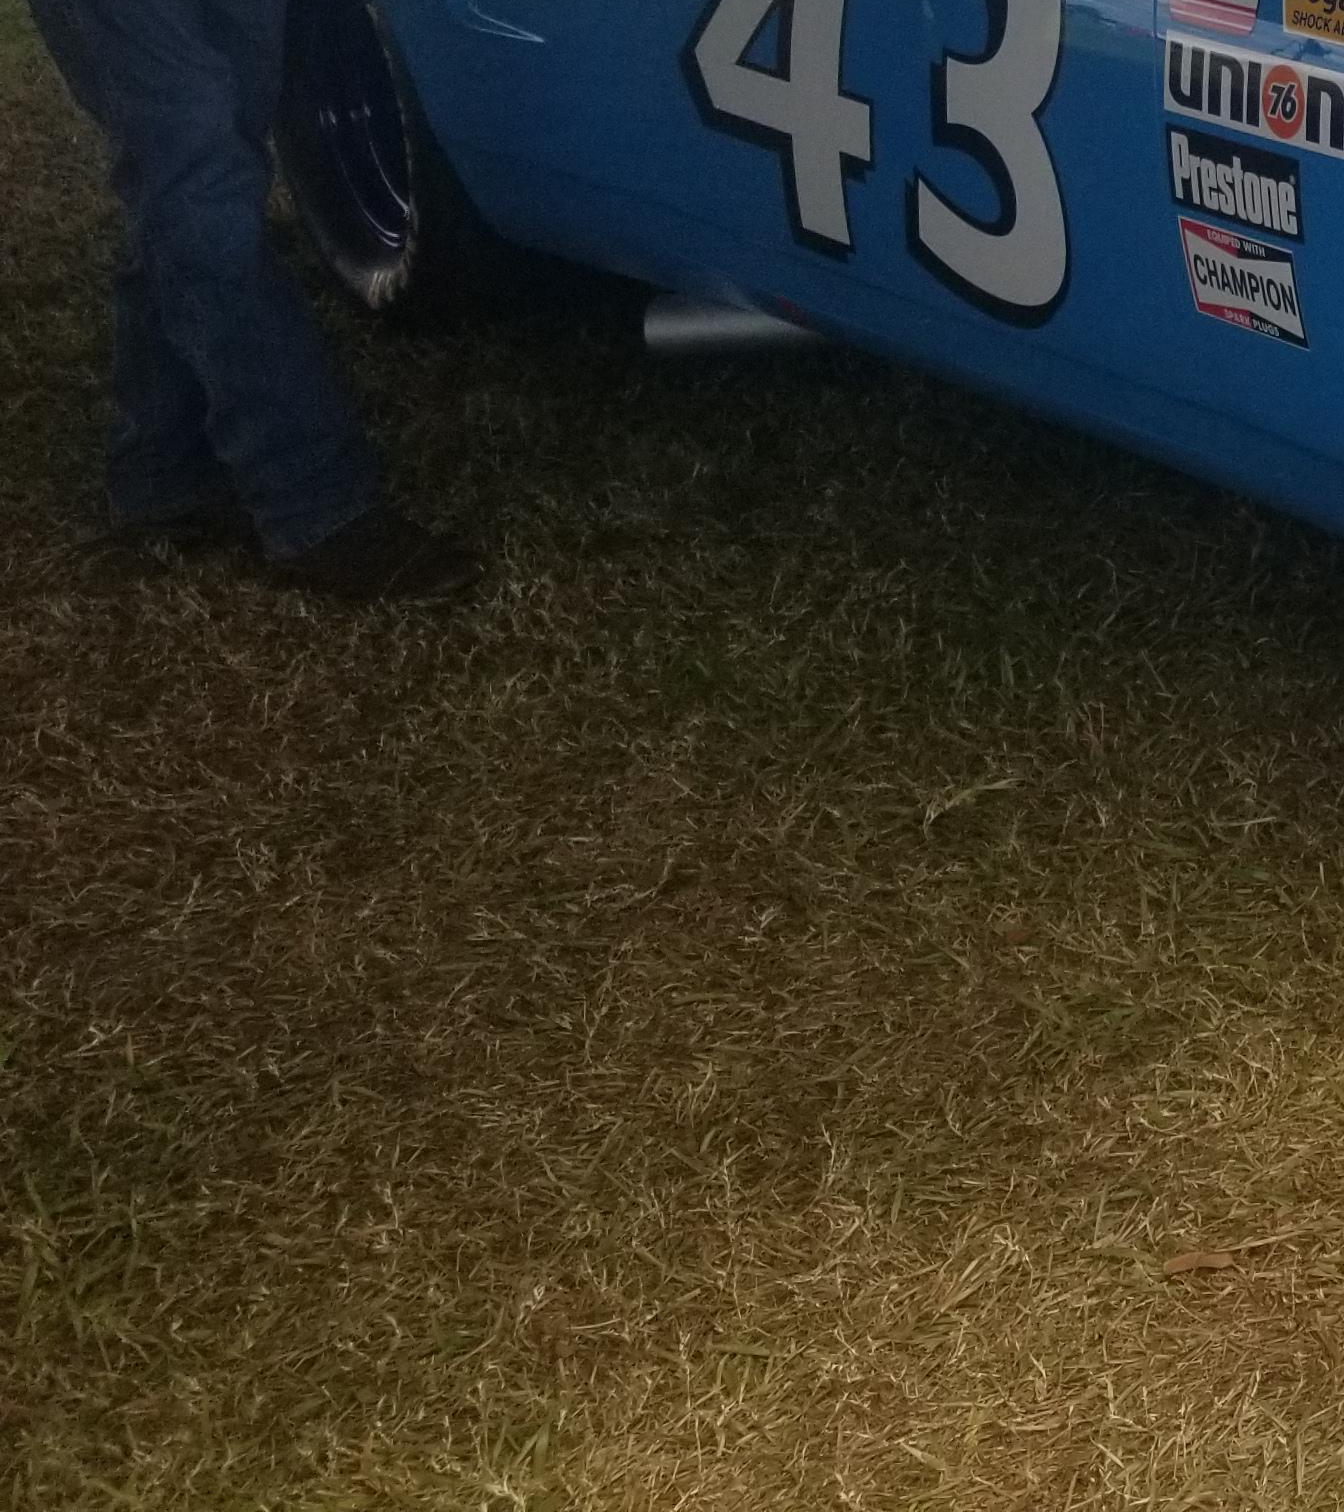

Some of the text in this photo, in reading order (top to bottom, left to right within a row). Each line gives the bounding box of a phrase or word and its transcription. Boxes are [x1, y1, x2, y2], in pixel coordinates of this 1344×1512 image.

[1292, 10, 1332, 33] SHOCK
[1268, 83, 1298, 123] 76
[1170, 131, 1299, 236] Prestone
[1243, 241, 1266, 257] WITH
[1194, 254, 1297, 316] CHAMPION
[1252, 318, 1280, 337] PLUGS
